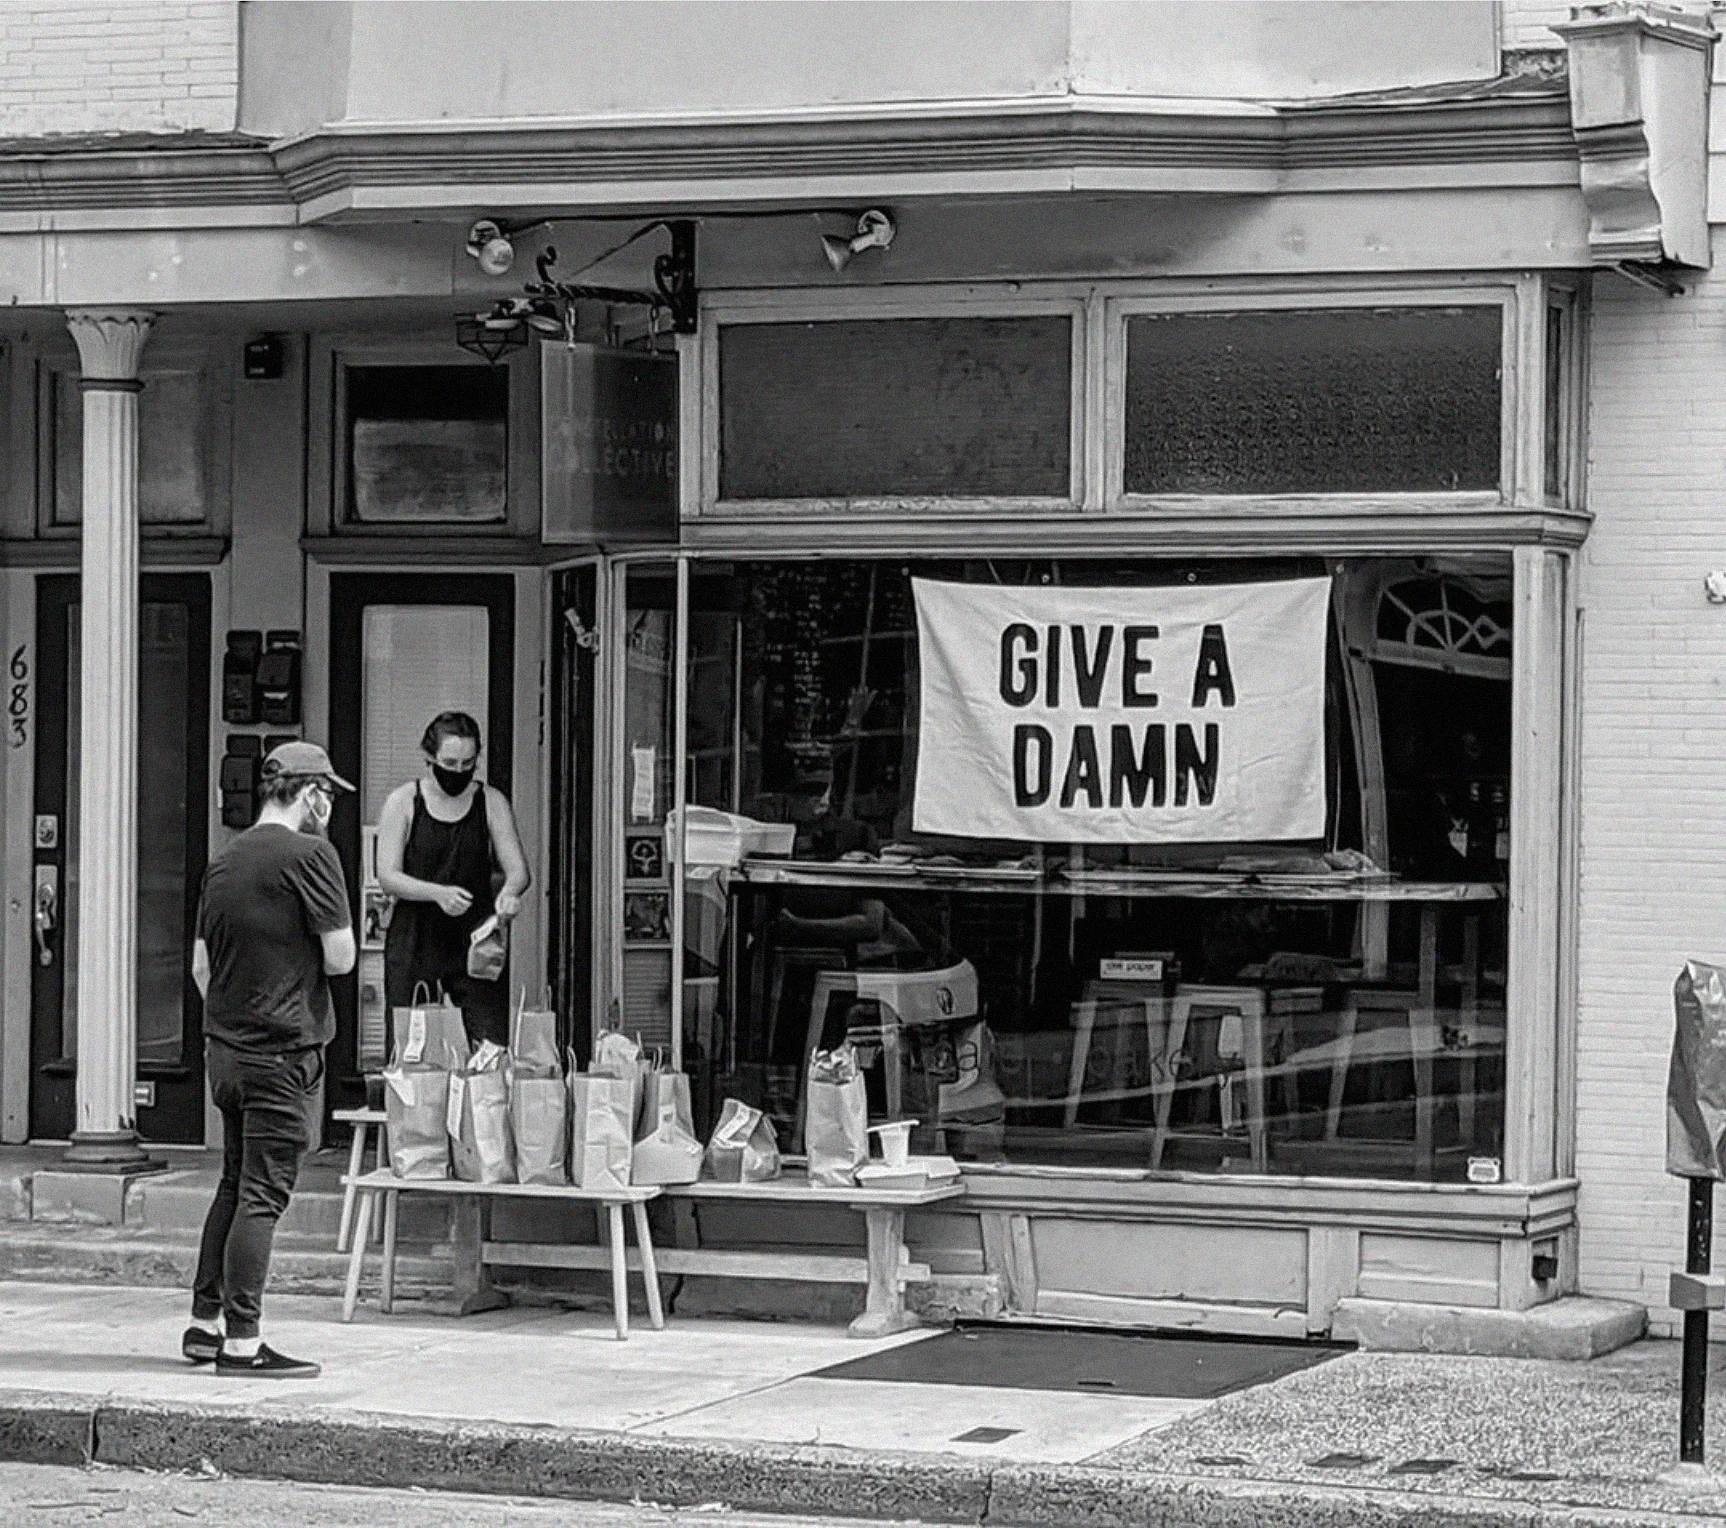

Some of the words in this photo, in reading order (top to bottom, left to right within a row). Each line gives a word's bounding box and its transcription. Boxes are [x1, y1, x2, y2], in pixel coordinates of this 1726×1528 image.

[9, 644, 28, 749] 683
[1000, 623, 1159, 708] GIVE
[1191, 624, 1236, 708] A
[1013, 723, 1219, 808] DAMN
